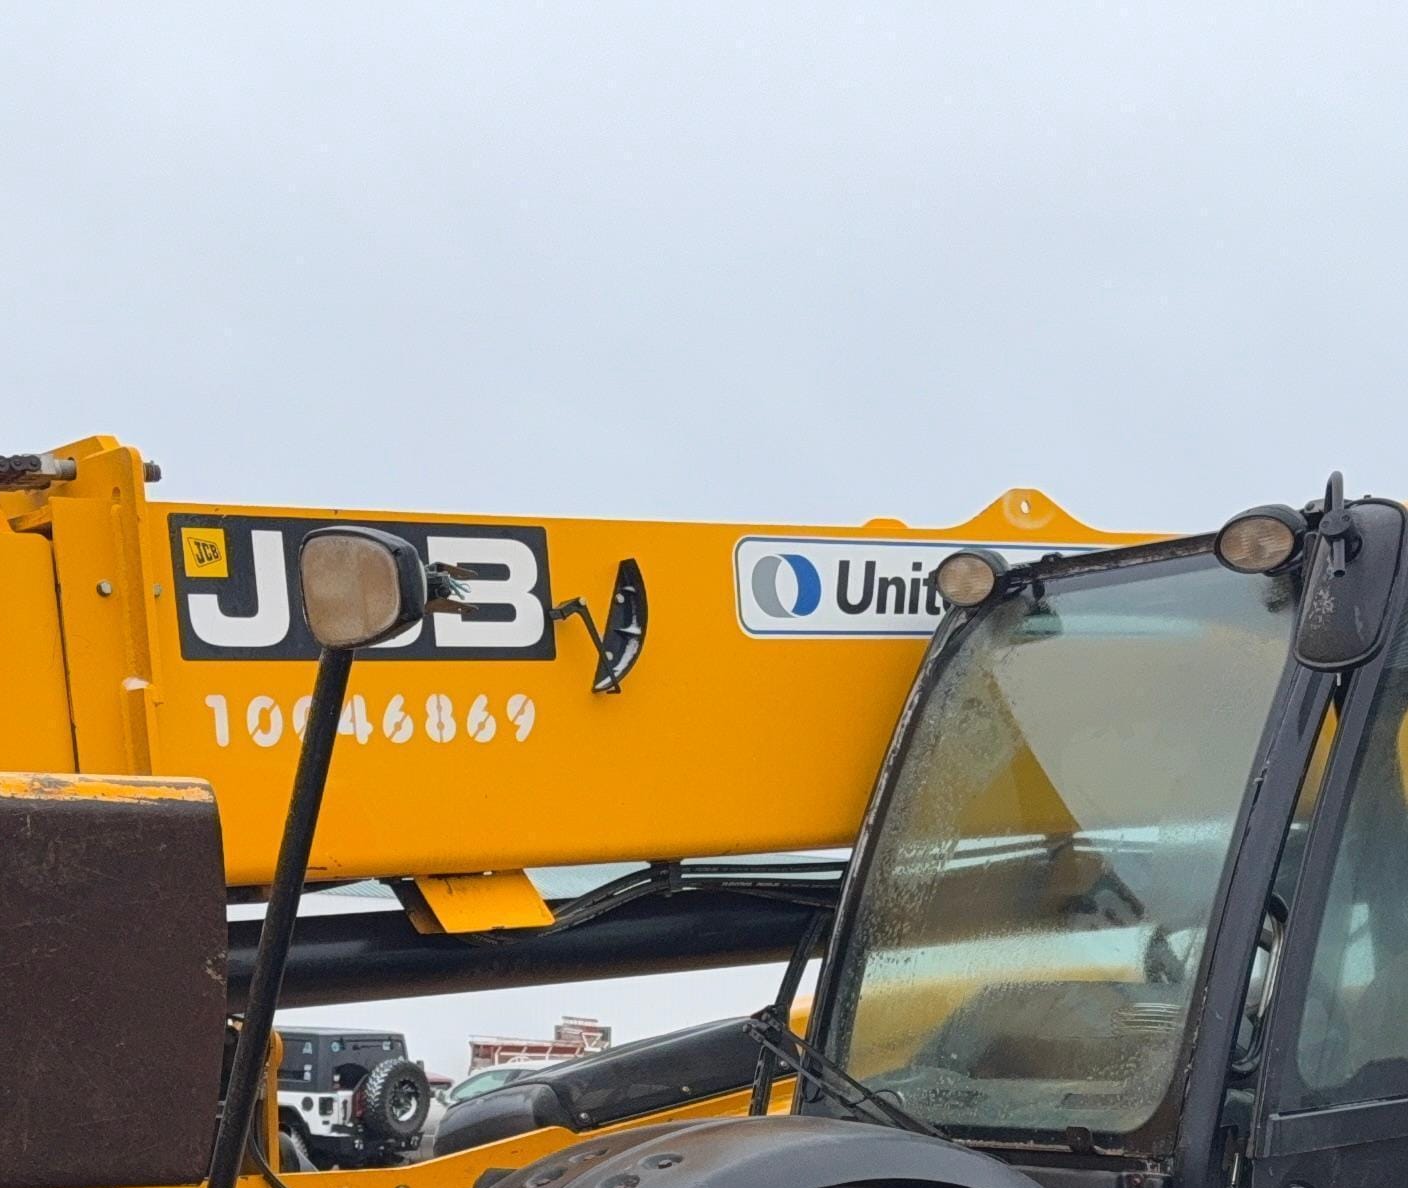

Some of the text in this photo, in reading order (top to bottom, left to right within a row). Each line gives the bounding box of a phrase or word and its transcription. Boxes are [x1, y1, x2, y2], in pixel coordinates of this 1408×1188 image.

[194, 540, 219, 564] JCB
[187, 529, 546, 648] JB
[836, 559, 950, 616] Unit
